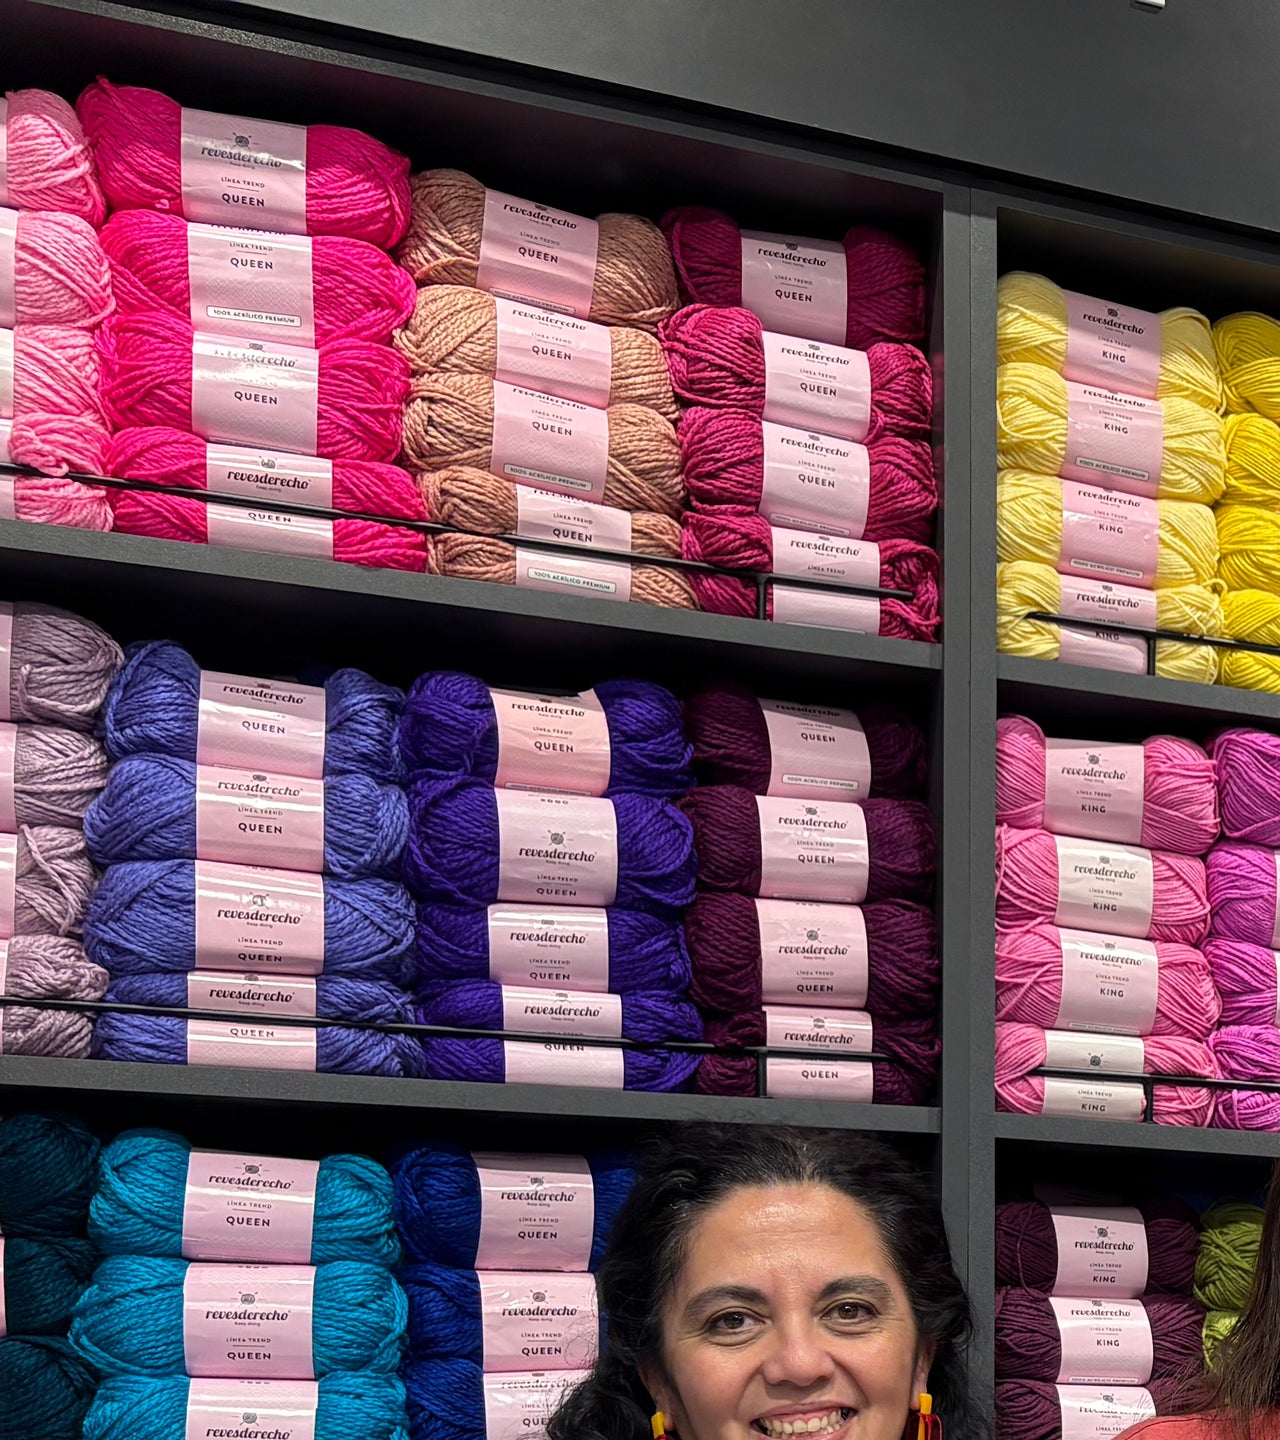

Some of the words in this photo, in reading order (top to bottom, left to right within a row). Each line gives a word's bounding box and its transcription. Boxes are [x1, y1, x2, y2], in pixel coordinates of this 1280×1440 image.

[222, 193, 264, 207] QUEEN
[504, 203, 577, 229] revesderecho
[518, 247, 559, 264] QUEEN
[758, 248, 826, 267] revesderecho
[230, 258, 273, 269] QUEEN
[775, 289, 812, 302] QUEEN
[513, 309, 586, 330] revesderecho
[1083, 312, 1144, 335] revesderecho
[532, 346, 572, 361] QUEEN
[782, 347, 849, 365] revesderecho
[1102, 351, 1126, 363] KING
[800, 383, 837, 396] QUEEN
[234, 391, 278, 404] QUEEN
[532, 422, 572, 436] QUEEN
[1105, 423, 1128, 434] KING
[781, 437, 849, 458] revesderecho
[228, 470, 308, 490] revesderecho
[799, 474, 835, 488] QUEEN
[248, 512, 291, 522] QUEEN
[553, 528, 592, 542] QUEEN
[1099, 524, 1123, 534] KING
[791, 540, 859, 556] revesderecho
[1077, 592, 1140, 609] revesderecho
[223, 684, 304, 704] revesderecho
[512, 702, 585, 717] revesderecho
[242, 720, 286, 735] QUEEN
[534, 741, 574, 753] QUEEN
[1062, 765, 1126, 780] revesderecho
[218, 780, 300, 797] revesderecho
[1081, 803, 1106, 813] KING
[238, 822, 282, 834] QUEEN
[519, 846, 595, 863] revesderecho
[798, 854, 835, 865] QUEEN
[1075, 864, 1135, 880] revesderecho
[1093, 902, 1117, 912] KING
[217, 908, 301, 925] revesderecho
[510, 930, 586, 944] revesderecho
[779, 943, 848, 957] revesderecho
[238, 952, 282, 964] QUEEN
[529, 971, 570, 981] QUEEN
[209, 987, 292, 1003] revesderecho
[796, 984, 834, 993] QUEEN
[1100, 988, 1124, 998] KING
[525, 1003, 599, 1018] revesderecho
[230, 1028, 274, 1038] QUEEN
[802, 1069, 839, 1079] QUEEN
[1081, 1102, 1106, 1112] KING
[209, 1172, 293, 1189] revesderecho
[501, 1191, 575, 1203] revesderecho
[226, 1215, 270, 1227] QUEEN
[518, 1230, 558, 1240] QUEEN
[1075, 1240, 1134, 1251] revesderecho
[1093, 1275, 1116, 1283] KING
[206, 1307, 289, 1322] revesderecho
[502, 1305, 577, 1316] revesderecho
[227, 1352, 271, 1360] QUEEN
[522, 1346, 561, 1356] QUEEN
[206, 1427, 291, 1440] revesderecho
